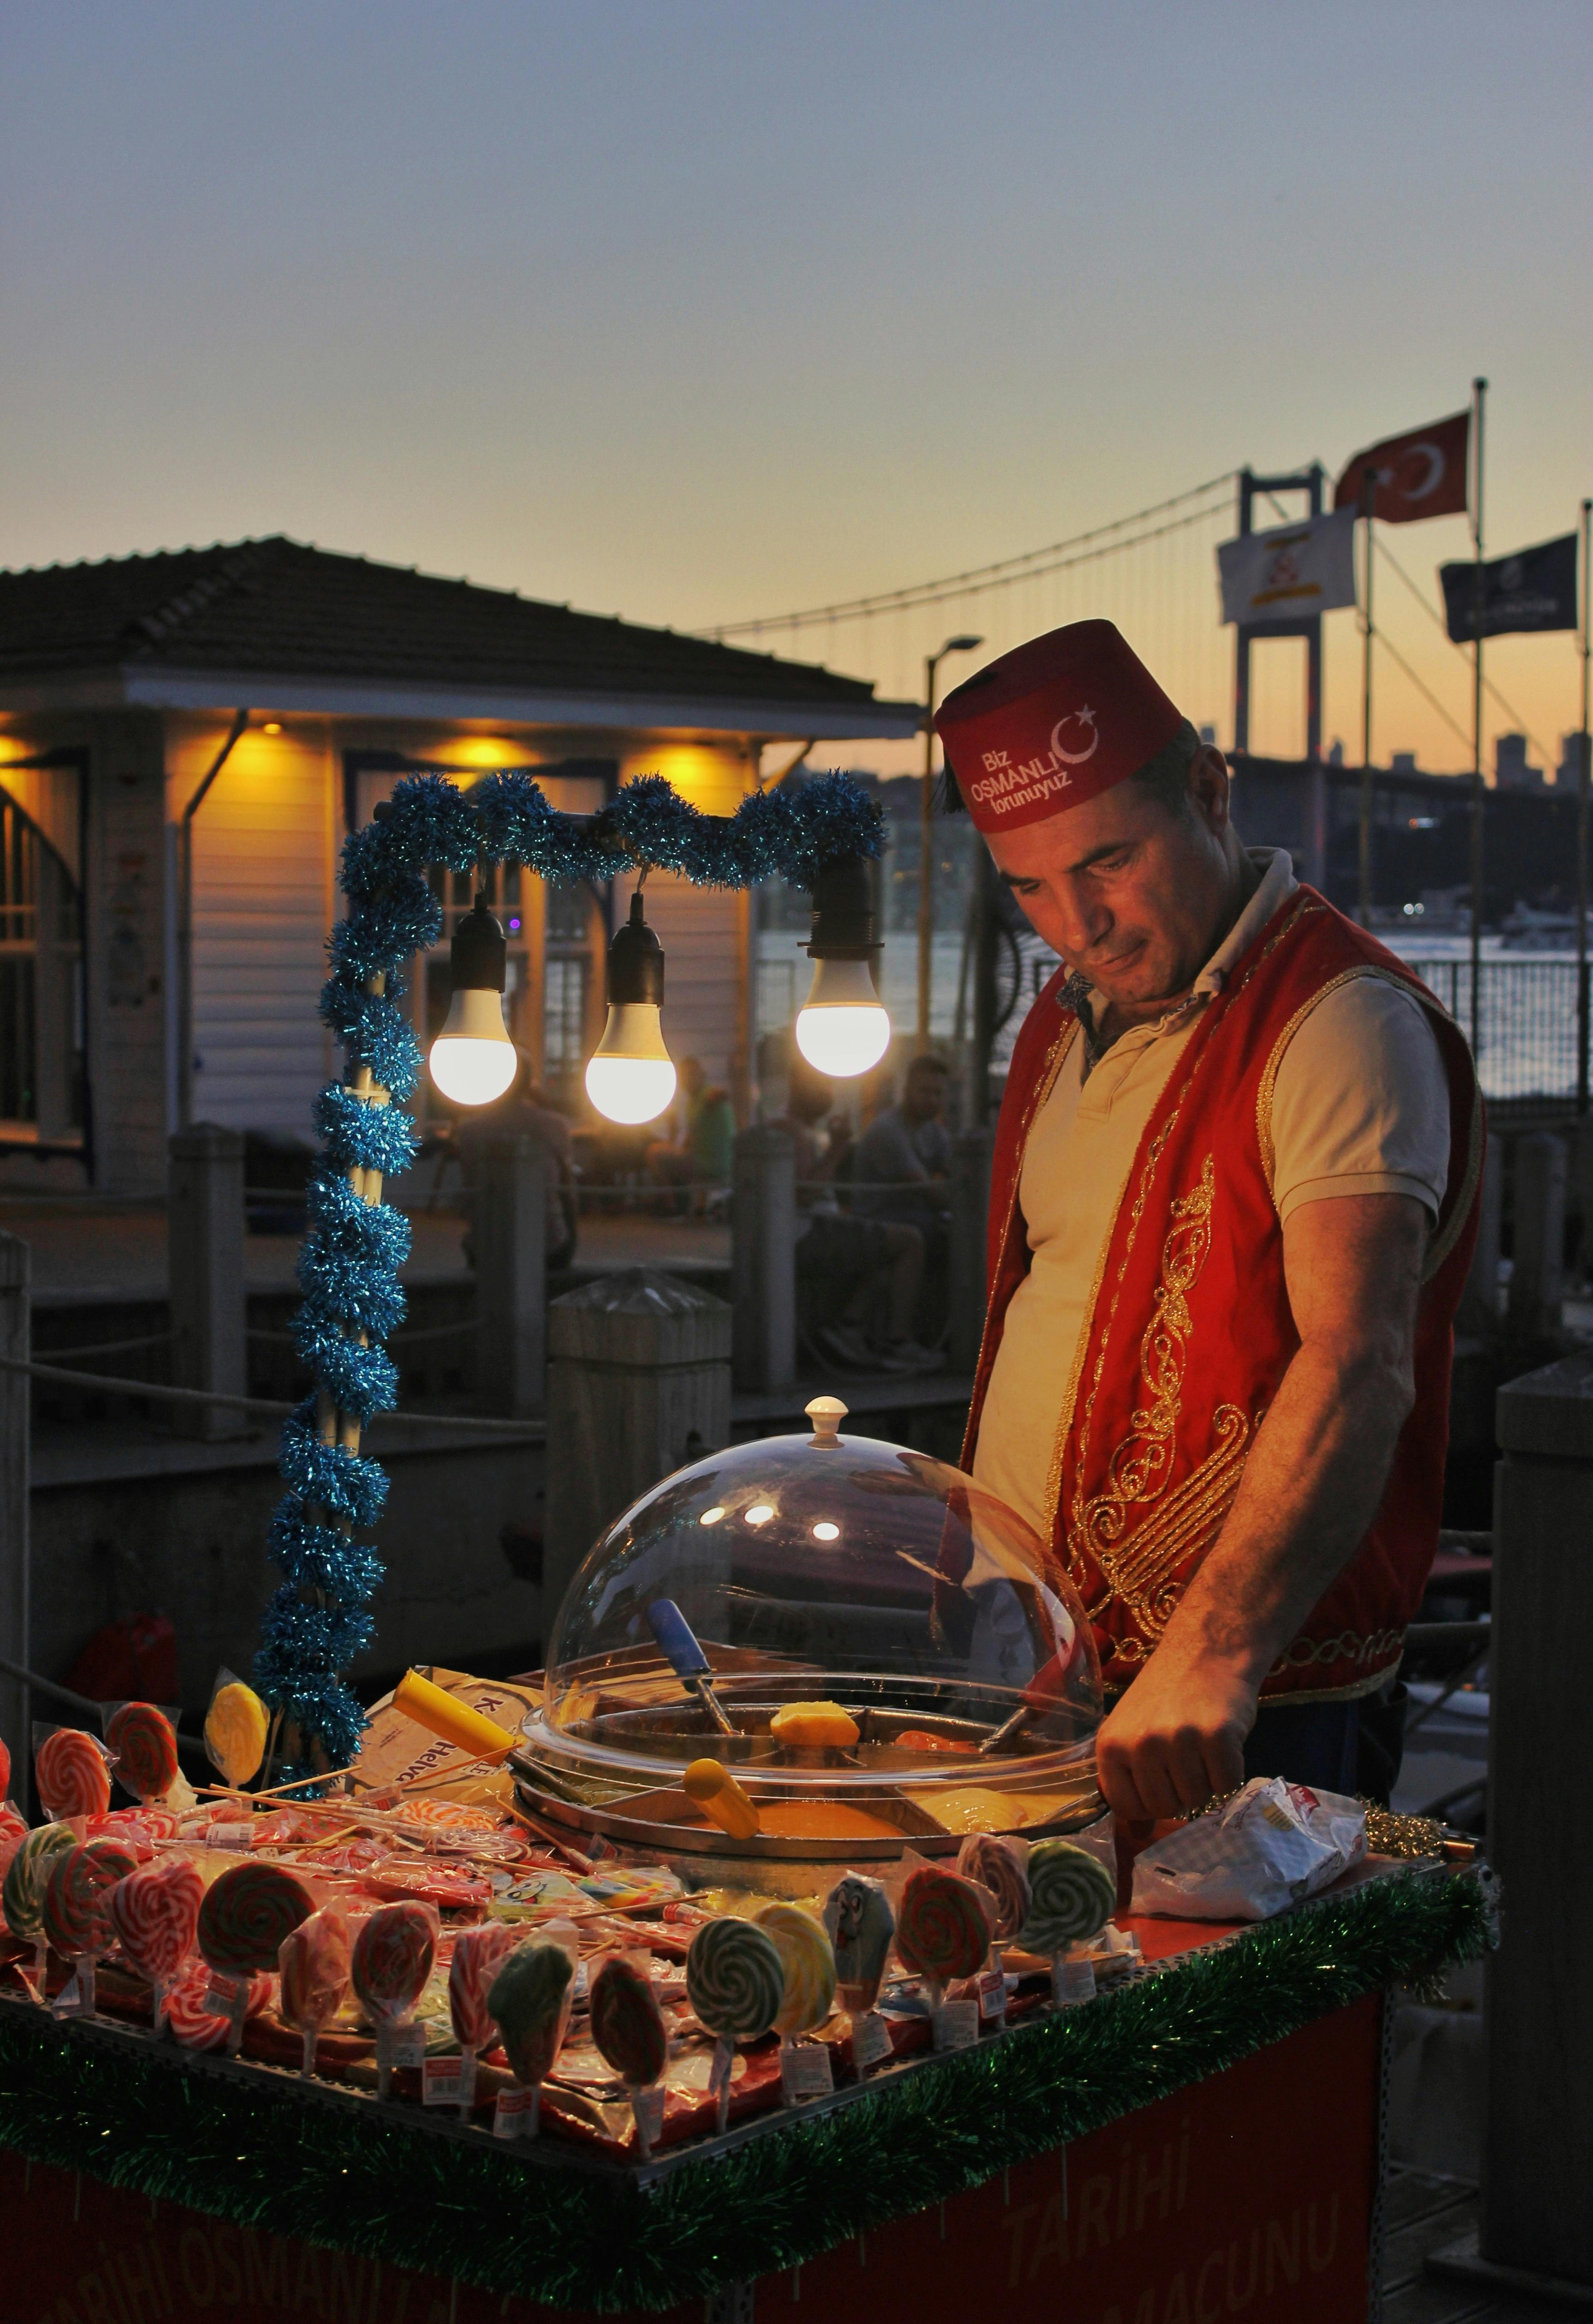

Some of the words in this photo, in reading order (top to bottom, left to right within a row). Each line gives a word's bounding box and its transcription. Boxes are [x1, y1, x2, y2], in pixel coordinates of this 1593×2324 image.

[971, 751, 1059, 802] OSMANLI
[981, 750, 1012, 772] Biz
[990, 771, 1073, 814] torunuyuz
[395, 1741, 457, 1782] Helva
[1002, 2116, 1191, 2289] TARİHİ
